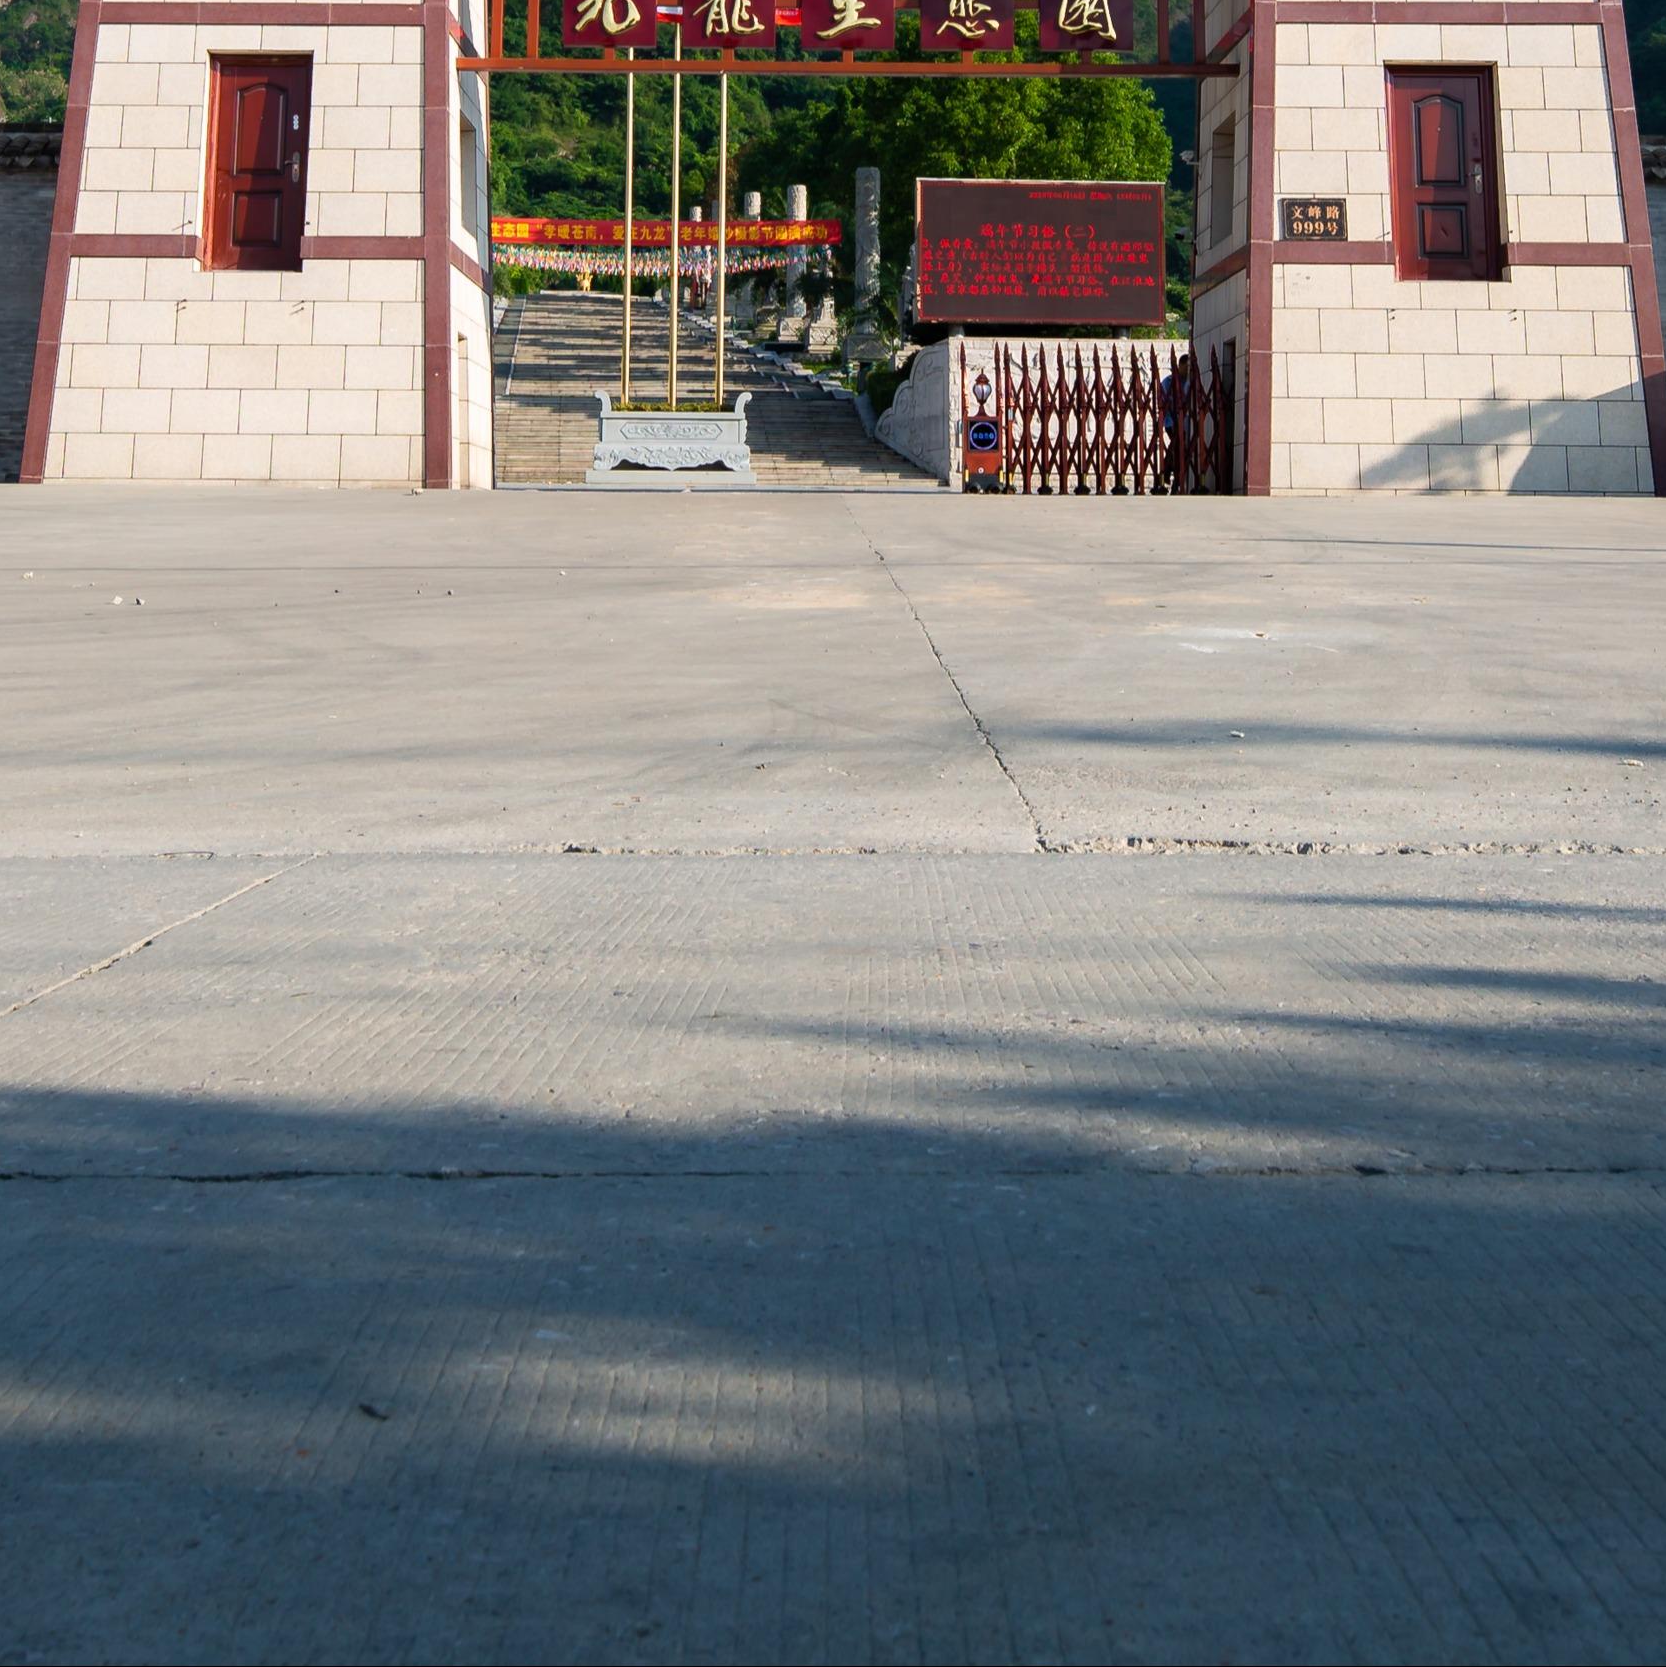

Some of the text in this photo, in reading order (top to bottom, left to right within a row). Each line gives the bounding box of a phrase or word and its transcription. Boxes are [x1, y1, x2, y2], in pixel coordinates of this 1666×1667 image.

[1291, 205, 1340, 219] 文峰路
[1292, 221, 1339, 235] 999号
